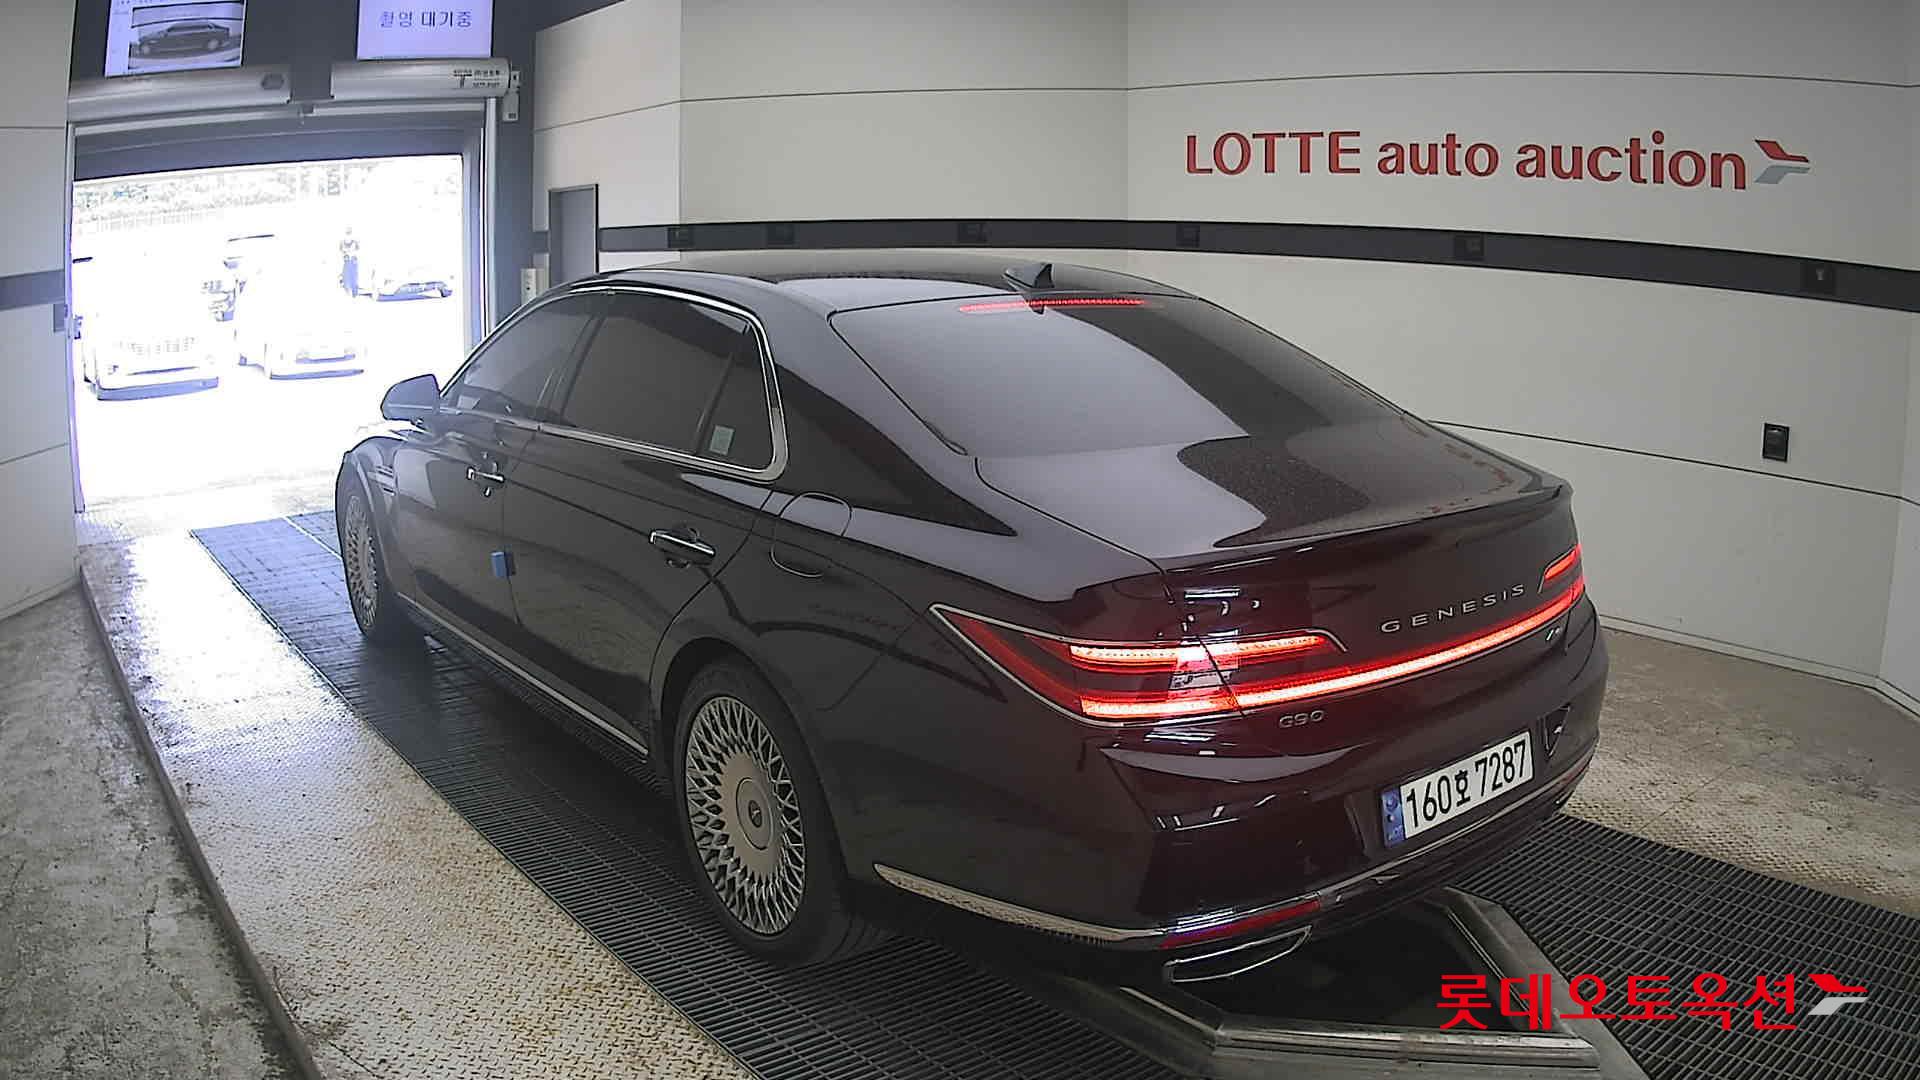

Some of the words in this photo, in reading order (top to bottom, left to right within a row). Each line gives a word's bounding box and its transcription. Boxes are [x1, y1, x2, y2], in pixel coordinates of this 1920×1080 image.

[421, 11, 471, 28] 대기중
[1186, 131, 1361, 175] LOTTE
[1378, 133, 1500, 177] auto
[1516, 131, 1747, 190] auction
[1381, 584, 1526, 633] GENESIS
[1279, 710, 1326, 728] G90
[1475, 740, 1527, 797] 7287
